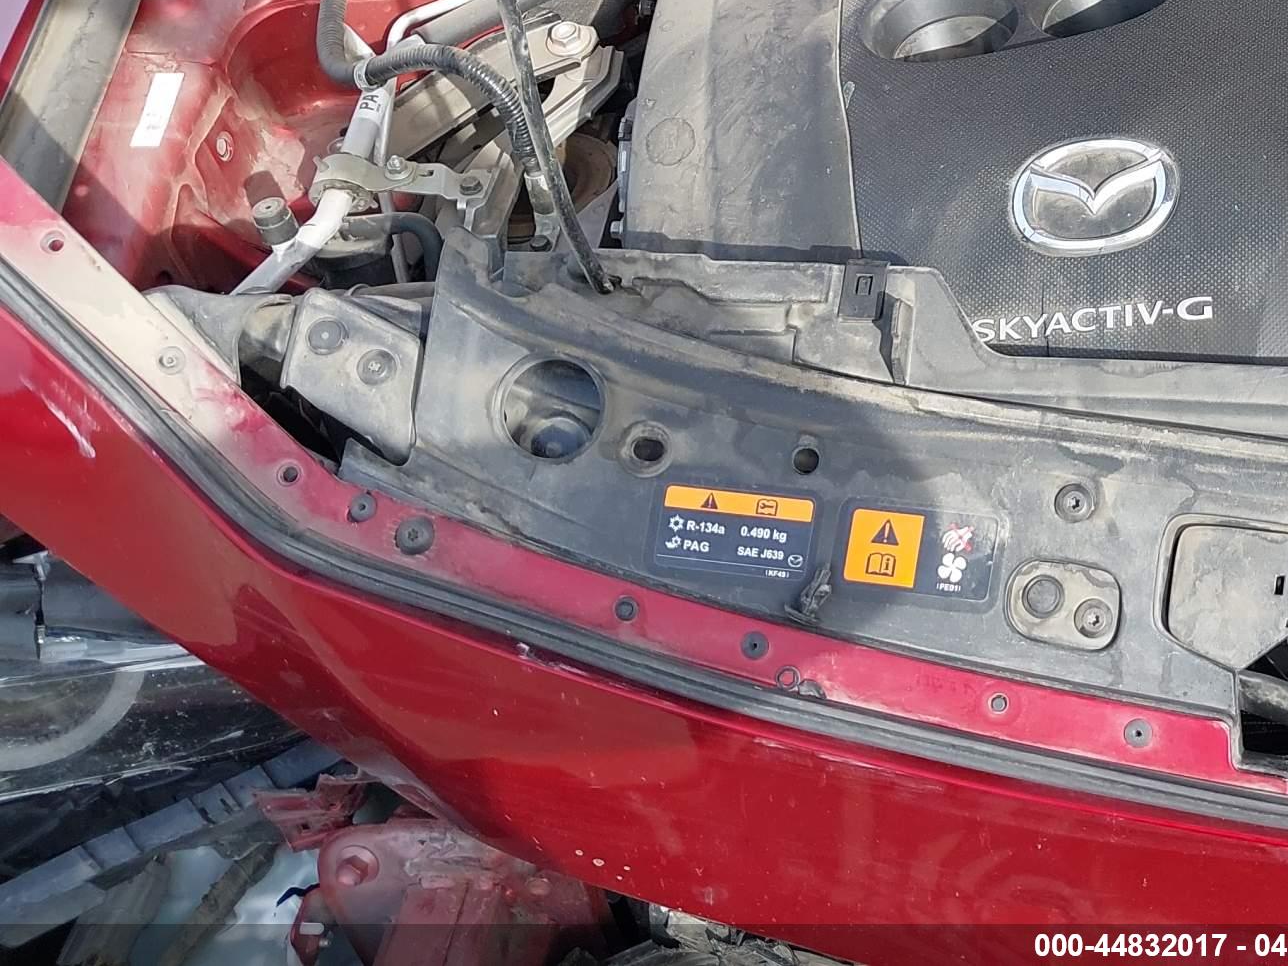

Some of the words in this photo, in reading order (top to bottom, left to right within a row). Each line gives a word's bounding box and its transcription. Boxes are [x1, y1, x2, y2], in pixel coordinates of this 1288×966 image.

[971, 296, 1213, 342] SKYACTIV-G
[687, 520, 725, 535] R-134a
[740, 525, 771, 539] 0.490
[772, 528, 788, 544] kg
[683, 539, 710, 552] PAG
[737, 546, 758, 558] SAE
[761, 548, 784, 560] J639
